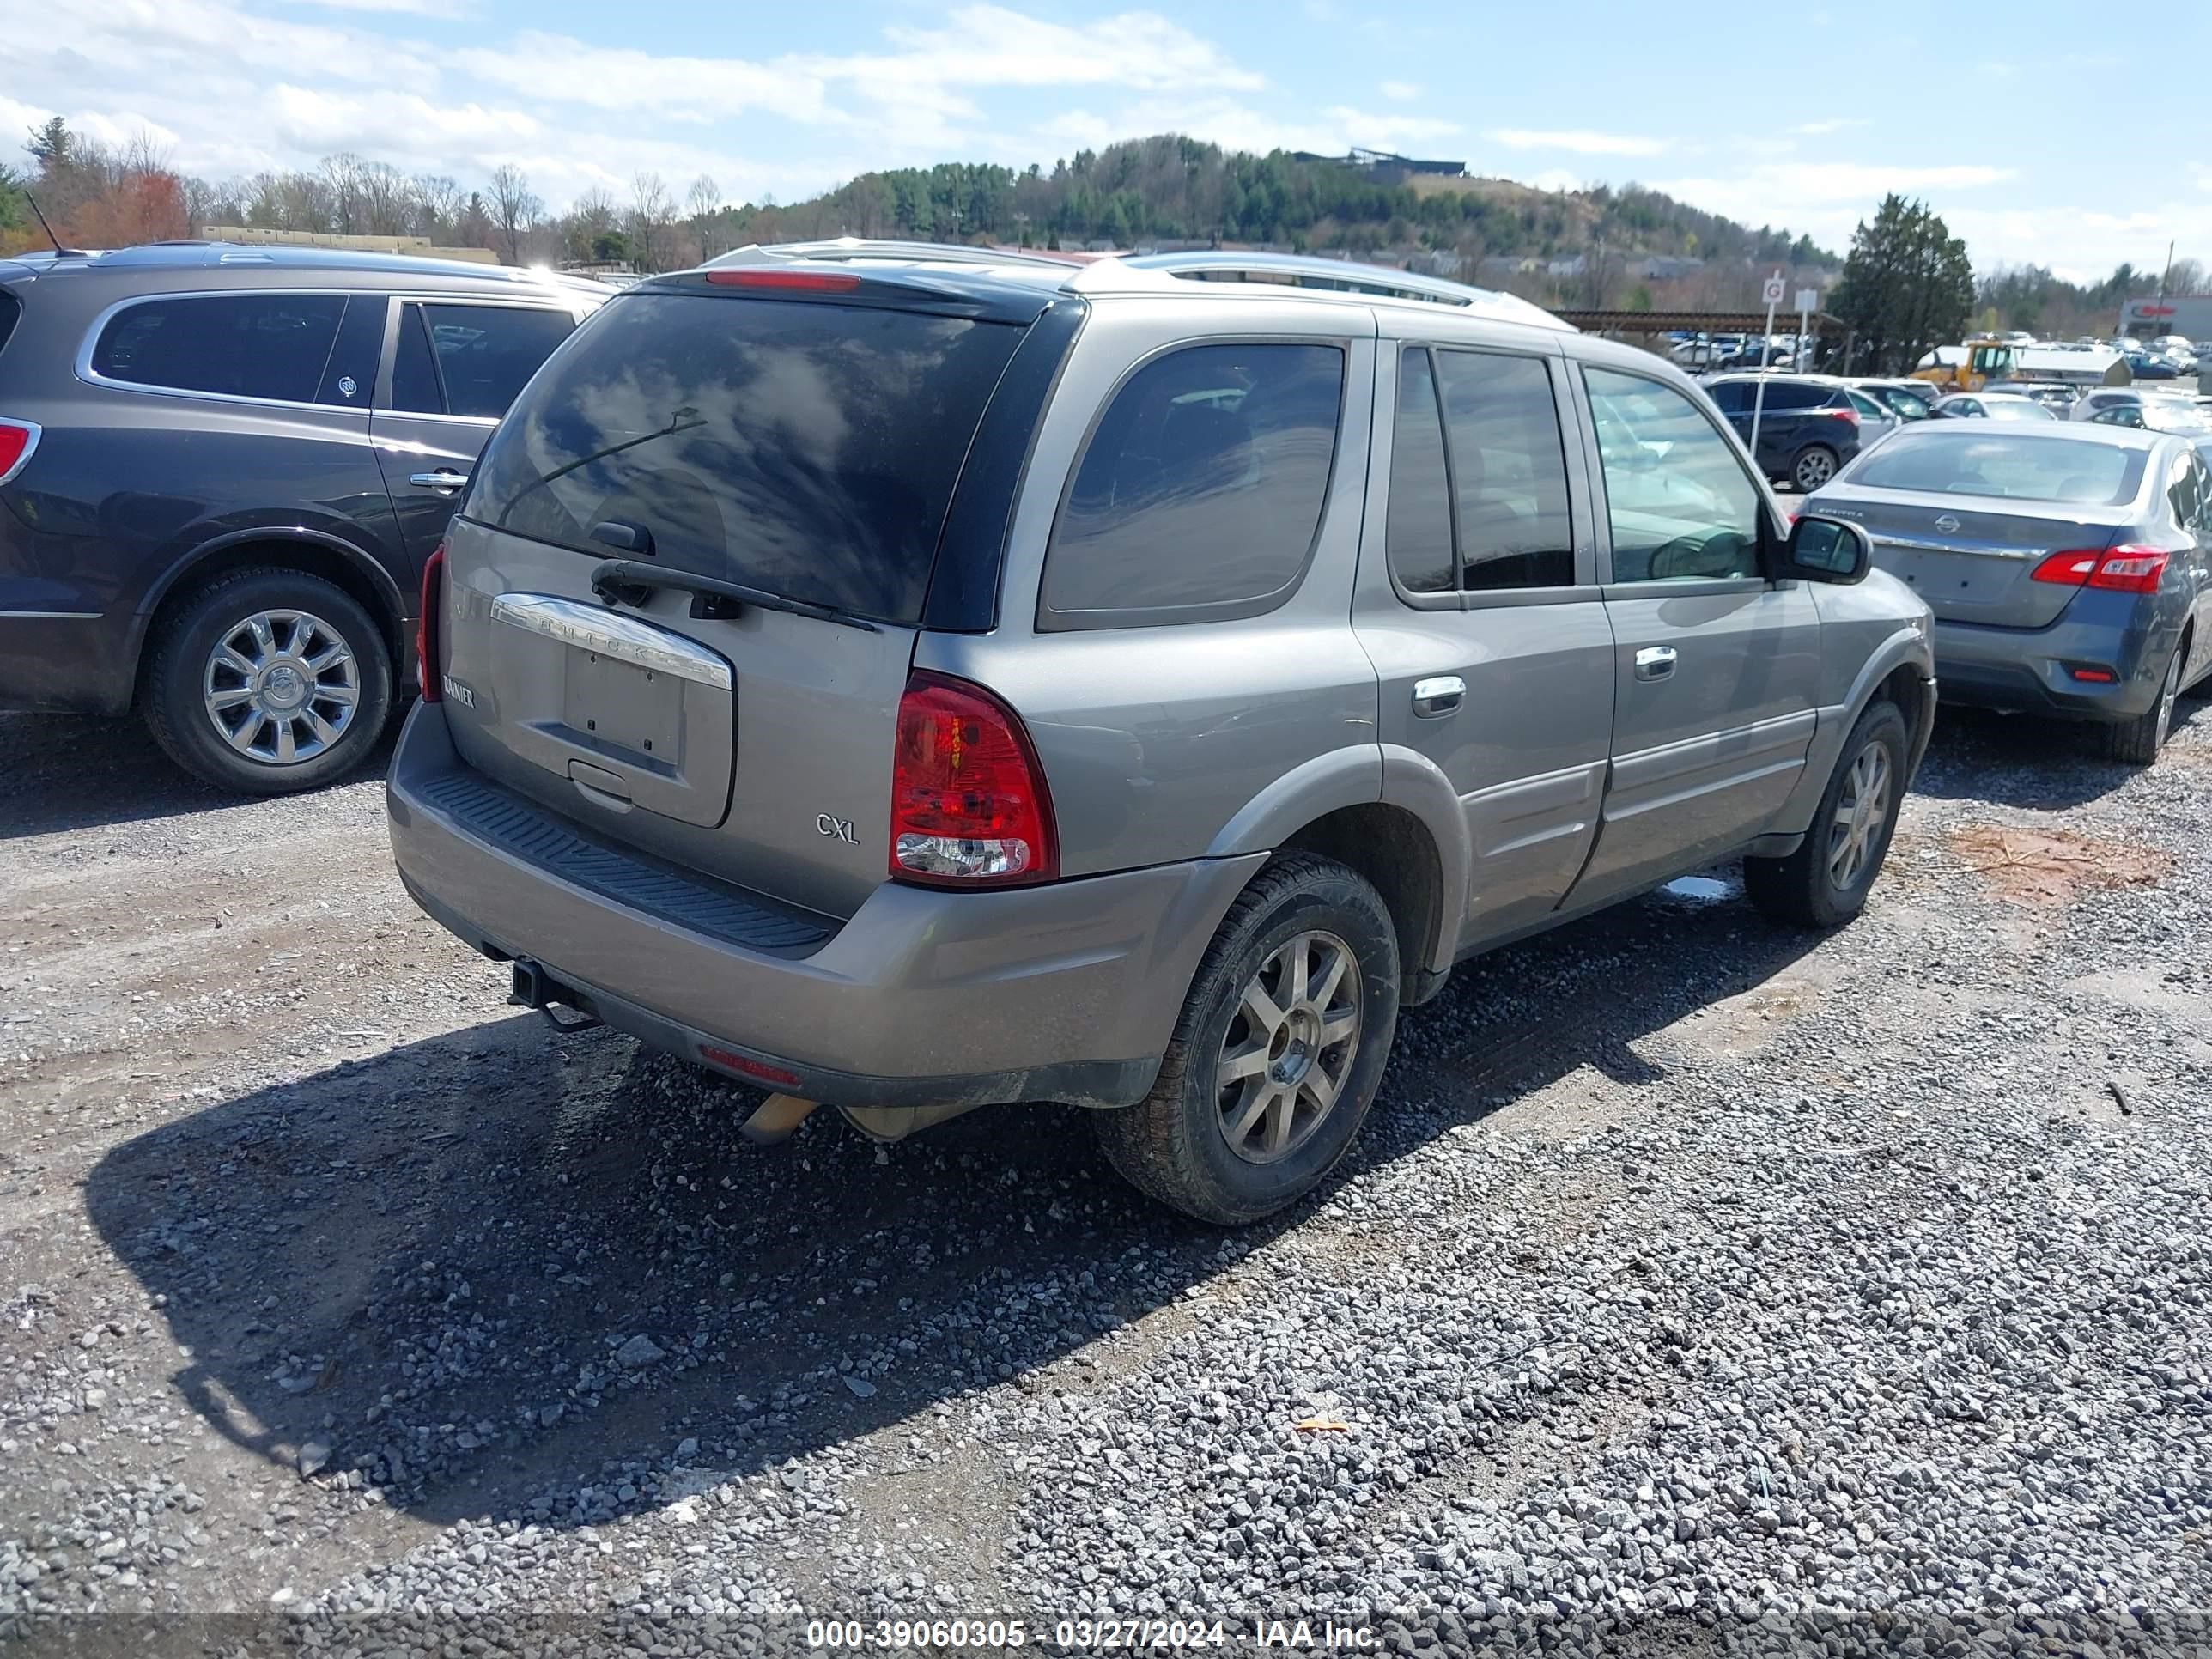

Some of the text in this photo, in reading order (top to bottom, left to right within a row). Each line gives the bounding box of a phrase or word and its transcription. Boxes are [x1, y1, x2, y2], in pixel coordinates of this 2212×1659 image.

[539, 617, 648, 660] BUICK
[442, 673, 475, 709] RAINIER
[817, 812, 860, 846] CXL
